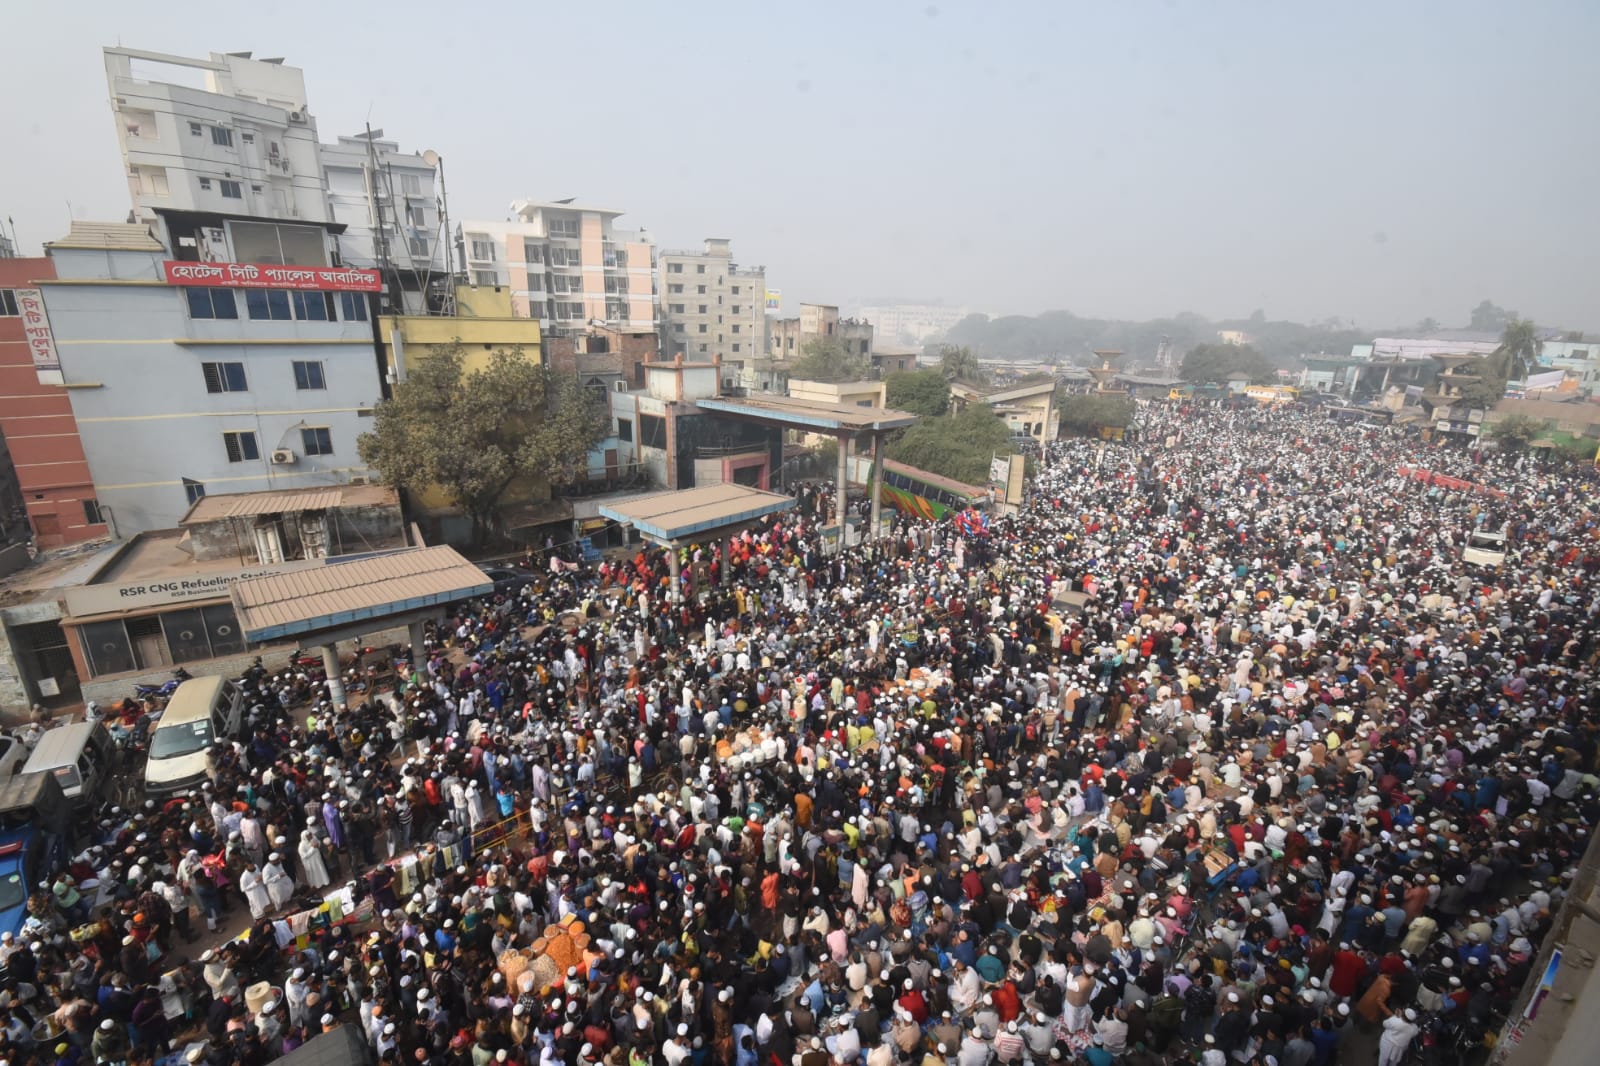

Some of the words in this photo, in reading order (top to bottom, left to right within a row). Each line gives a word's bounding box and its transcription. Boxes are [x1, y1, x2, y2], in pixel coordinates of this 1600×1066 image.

[171, 264, 223, 279] হোটেল
[229, 264, 259, 280] সিটি
[265, 268, 314, 282] প্যালেস
[318, 268, 376, 284] আবাসিক
[120, 587, 146, 597] RSR
[149, 582, 178, 593] CNG
[188, 587, 218, 596] Business
